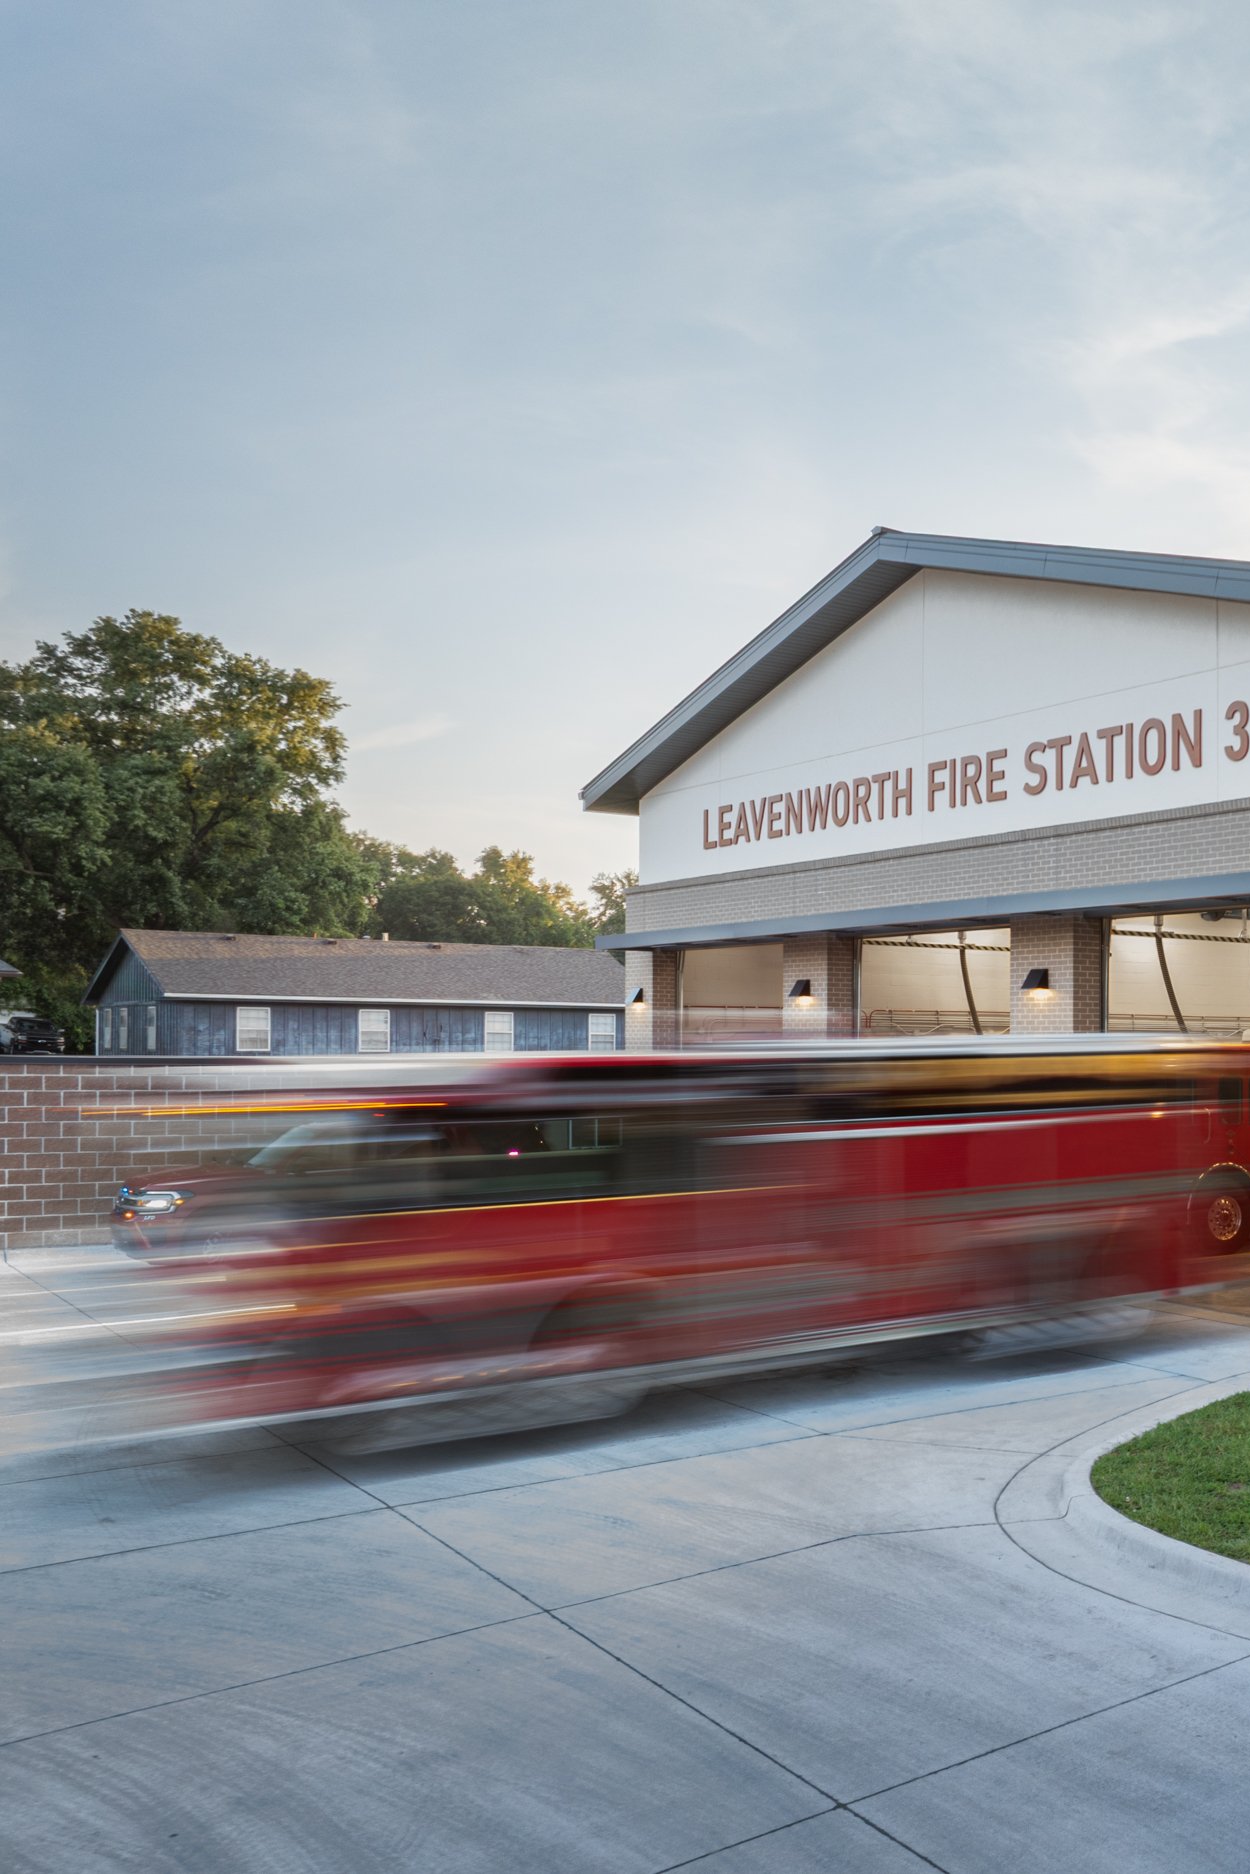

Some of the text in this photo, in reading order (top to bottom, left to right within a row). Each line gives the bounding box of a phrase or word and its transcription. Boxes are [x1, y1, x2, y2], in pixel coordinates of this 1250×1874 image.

[703, 700, 1250, 849] LEAVENWORTH FIRE STATION 3
